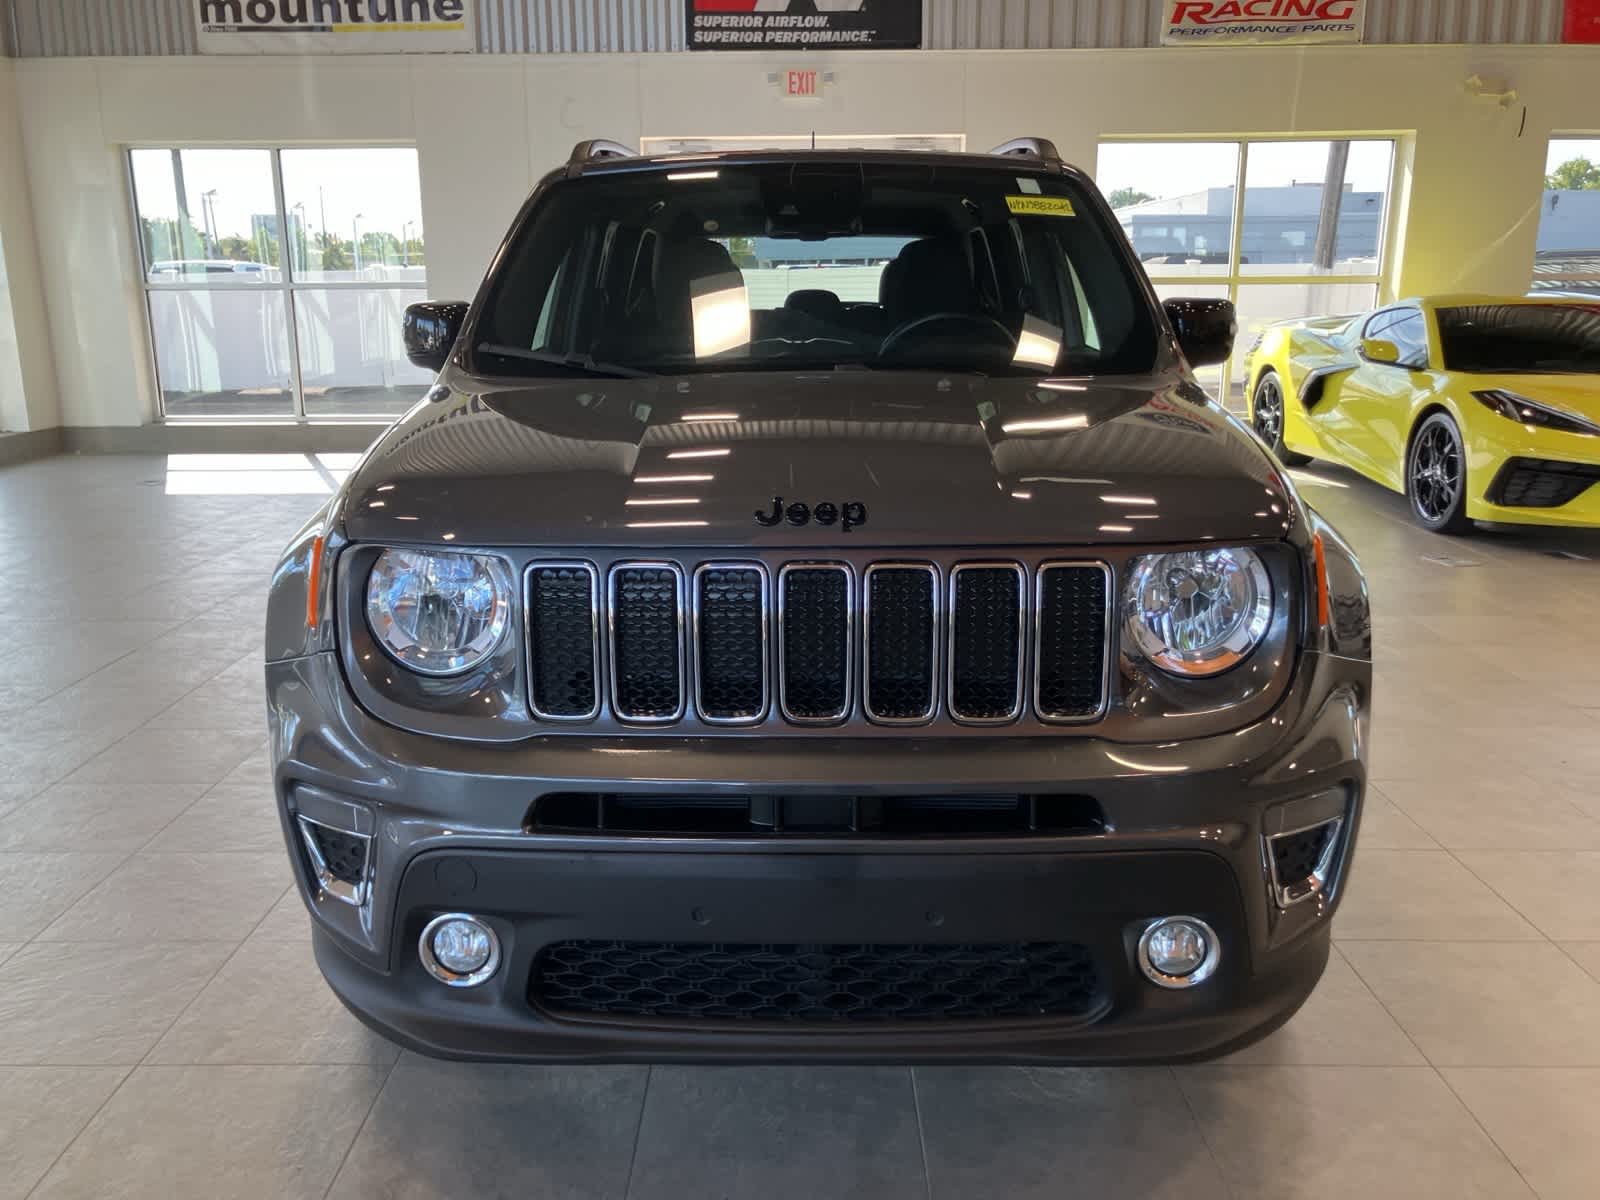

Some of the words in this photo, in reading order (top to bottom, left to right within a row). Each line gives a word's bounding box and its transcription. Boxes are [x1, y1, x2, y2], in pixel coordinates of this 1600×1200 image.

[200, 0, 464, 23] mountune
[693, 15, 763, 28] SUPERIOR
[764, 15, 830, 28] AIRFLOW.
[1170, 0, 1353, 24] RACING
[693, 30, 763, 43] SUPERIOR
[1168, 26, 1297, 35] PERFORMANCE
[1302, 24, 1355, 32] PARTS
[788, 71, 817, 95] EXIT
[754, 496, 866, 532] Jeep
